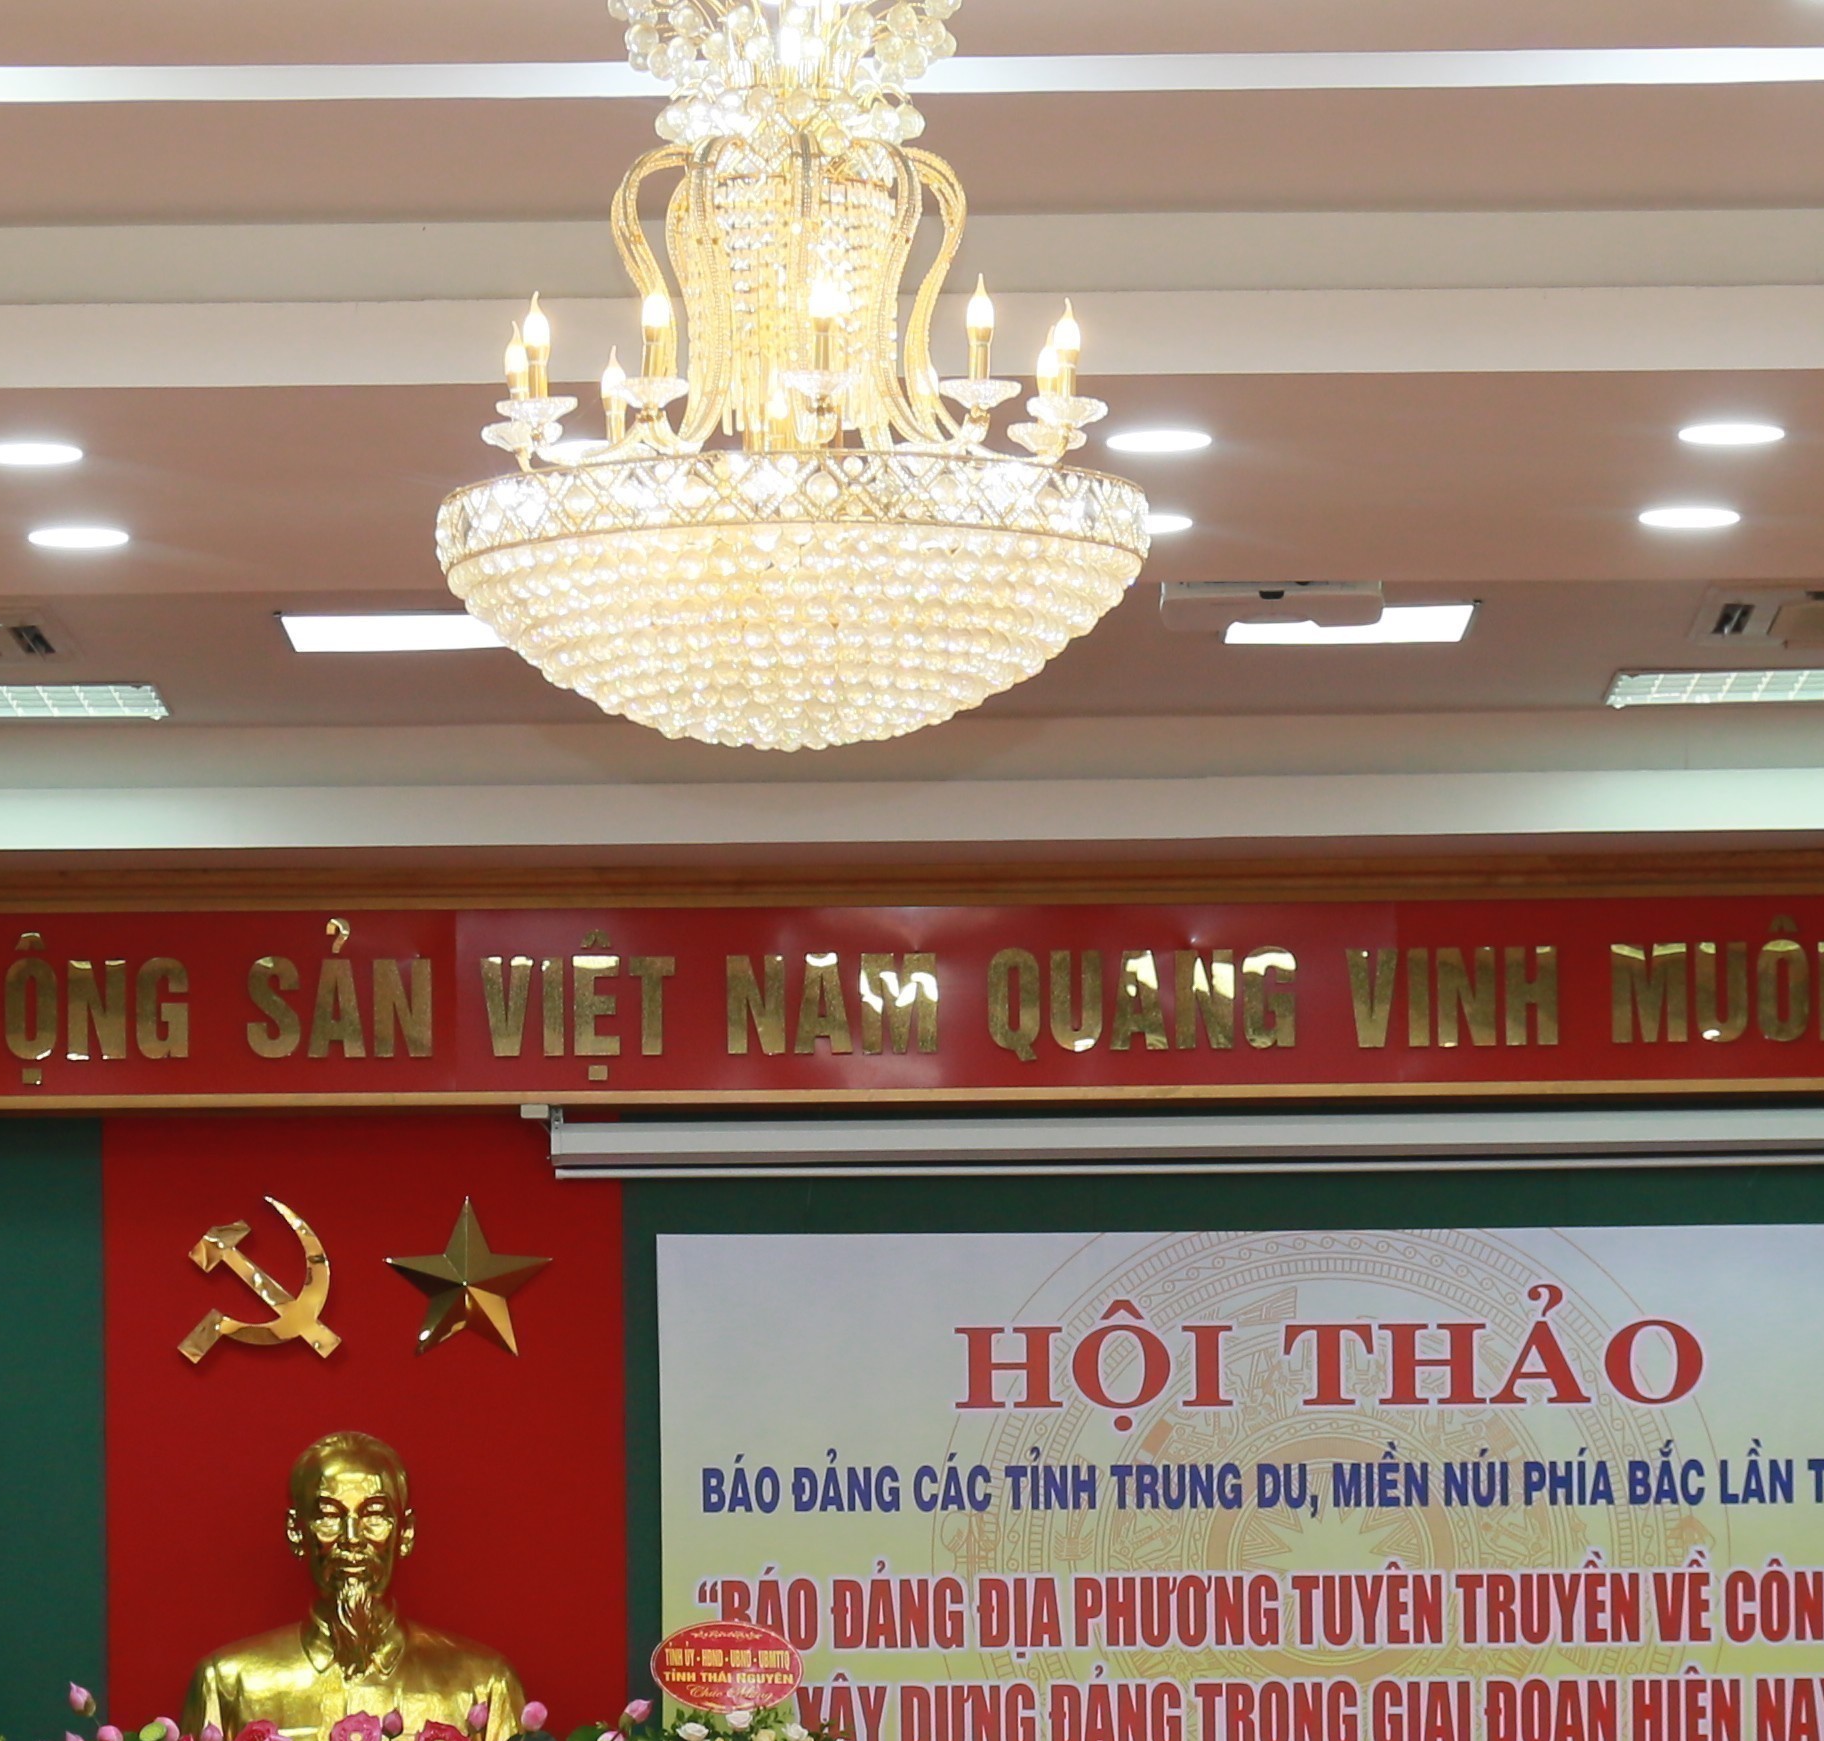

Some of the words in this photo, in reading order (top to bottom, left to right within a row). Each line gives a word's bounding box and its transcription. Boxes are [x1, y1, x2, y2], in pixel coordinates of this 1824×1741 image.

[245, 917, 433, 1058] SẢN
[479, 929, 676, 1082] VIỆT
[725, 952, 939, 1057] NAM
[985, 945, 1298, 1062] QUANG
[1345, 943, 1561, 1049] VINH
[954, 1300, 1234, 1432] HỘI
[1283, 1284, 1704, 1406] THẢO
[701, 1453, 781, 1513] BÁO
[792, 1448, 901, 1513] ĐẢNG
[913, 1453, 992, 1512] CÁC
[1005, 1446, 1097, 1511] TỈNH
[1110, 1463, 1243, 1510] TRUNG
[1256, 1463, 1320, 1518] DU,
[1332, 1441, 1429, 1508] MIỀN
[1442, 1447, 1510, 1507] NÚI
[1523, 1447, 1615, 1507] PHÍA
[1628, 1439, 1705, 1505] BẮC
[1719, 1438, 1794, 1504] LẦN
[831, 1560, 965, 1649] ĐẢNG
[978, 1575, 1062, 1659] ĐỊA
[1074, 1573, 1279, 1648] PHƯƠNG
[1292, 1561, 1443, 1646] TUYÊN
[1455, 1550, 1641, 1644] TRUYỀN
[1652, 1549, 1712, 1643] VỀ
[663, 1668, 696, 1683] TỈNH
[700, 1670, 732, 1684] THÁI
[736, 1671, 794, 1684] NGUYÊN
